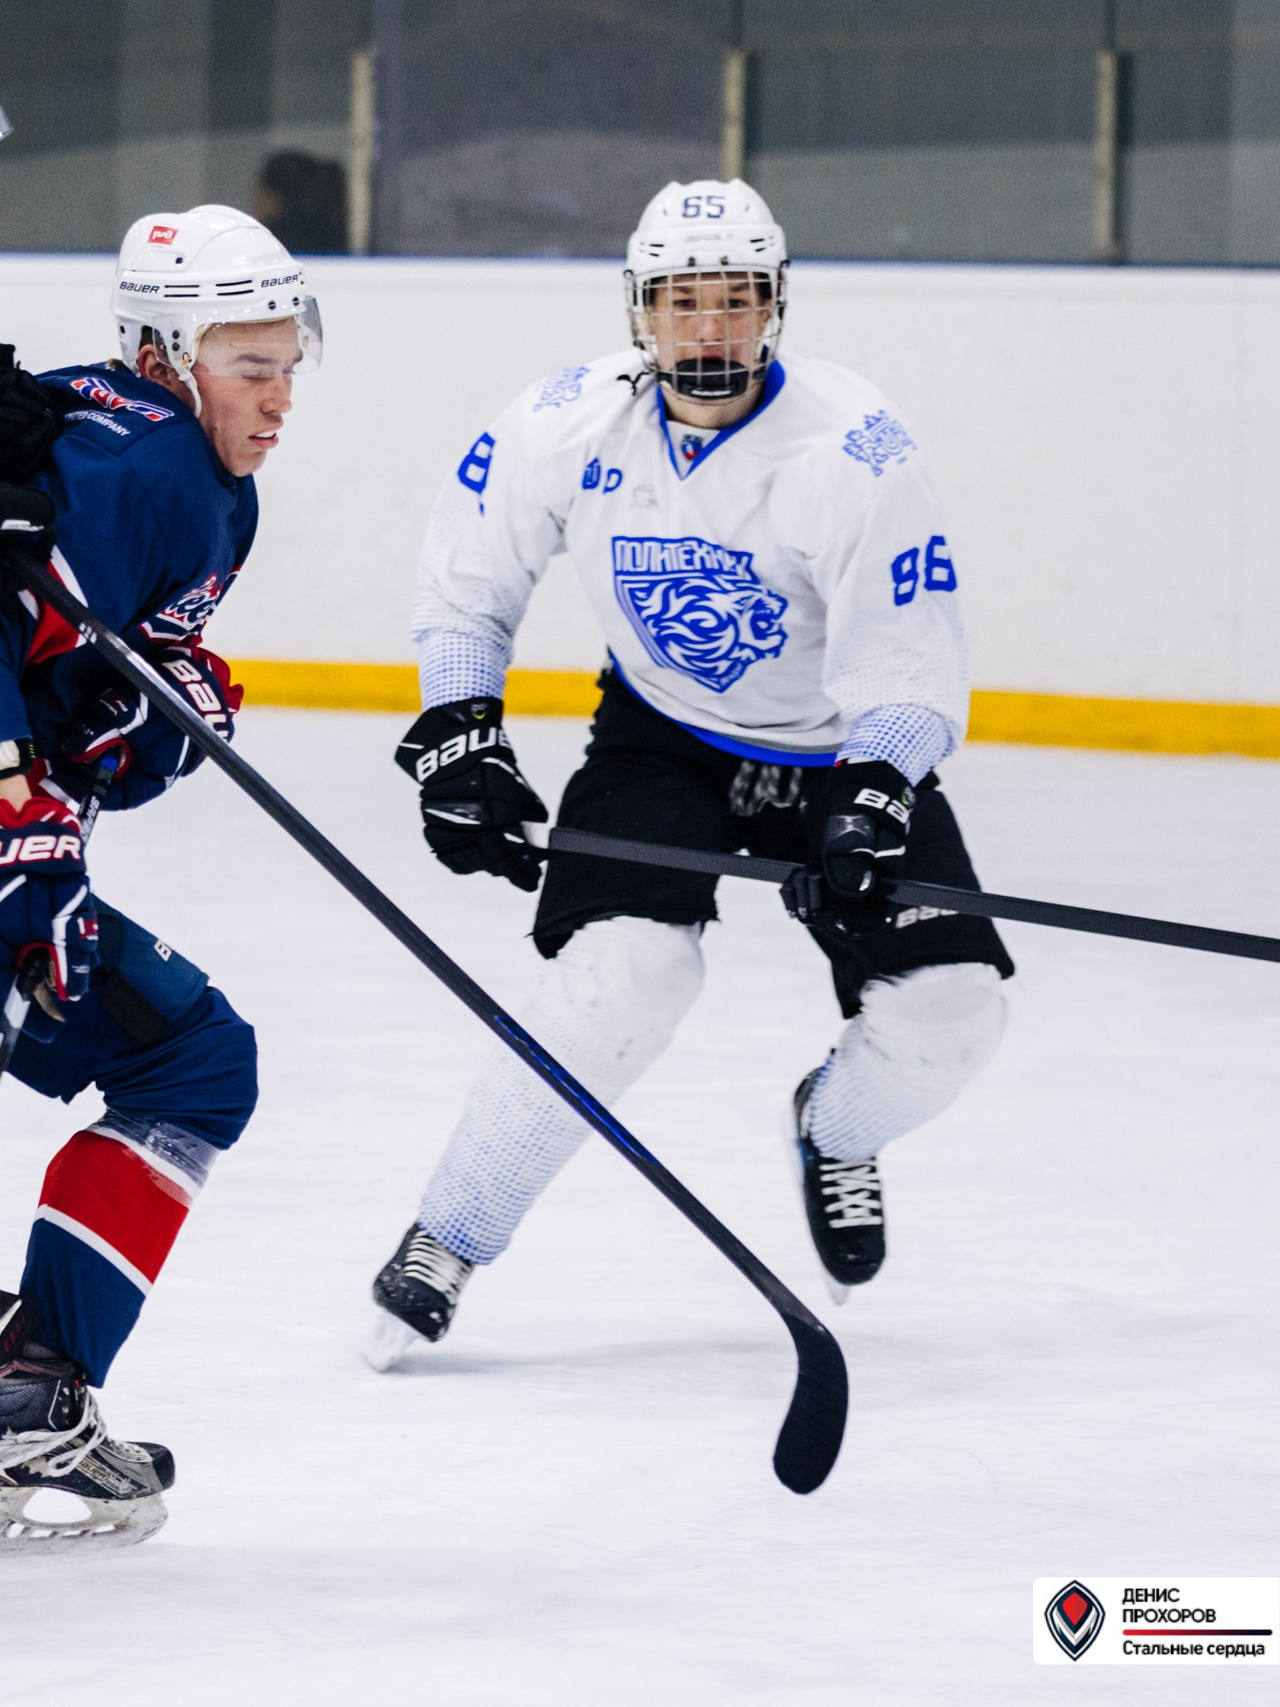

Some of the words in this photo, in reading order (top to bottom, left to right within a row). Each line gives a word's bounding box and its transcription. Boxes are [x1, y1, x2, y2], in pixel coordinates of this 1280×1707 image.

[682, 196, 726, 219] 65
[120, 281, 160, 294] BAUER
[261, 274, 299, 288] BAUER
[87, 412, 131, 437] COMPANY
[458, 432, 496, 516] 8
[891, 535, 958, 607] 86
